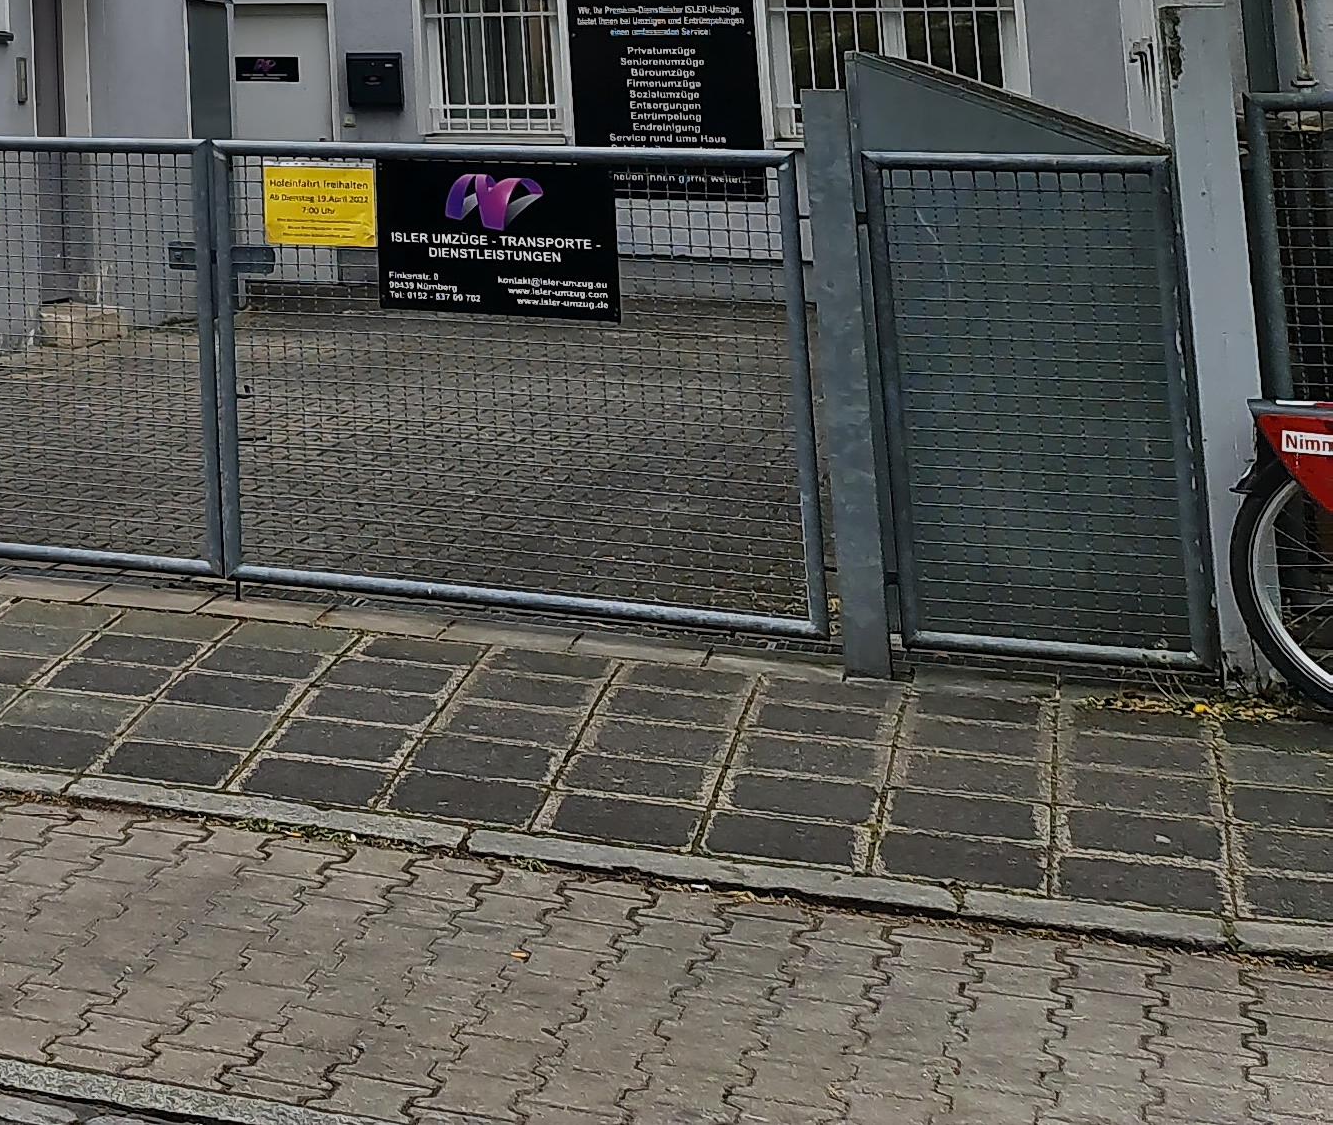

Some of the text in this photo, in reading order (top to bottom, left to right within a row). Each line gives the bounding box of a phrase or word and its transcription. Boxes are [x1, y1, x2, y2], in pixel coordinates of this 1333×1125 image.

[627, 47, 696, 57] Privatumzüge
[620, 57, 705, 68] Seniorenumzüge
[631, 68, 696, 78] Büroumzüge
[627, 79, 701, 89] Firmenumzüge
[629, 90, 700, 100] Sozialumzüge
[630, 101, 701, 111] Entsorgungen
[631, 112, 702, 123] Entrümpelung
[633, 123, 701, 133] Endreinigung
[610, 133, 647, 142] Service
[650, 134, 673, 143] rund
[701, 135, 727, 144] Haus
[270, 179, 368, 189] Hofeinfahrt freihalten
[390, 231, 429, 244] ISLER
[432, 231, 488, 246] UMZÜGE
[499, 235, 593, 250] TRANSPORTE
[429, 247, 561, 263] DIENSTLEISTUNGEN
[417, 282, 458, 293] Nürnberg
